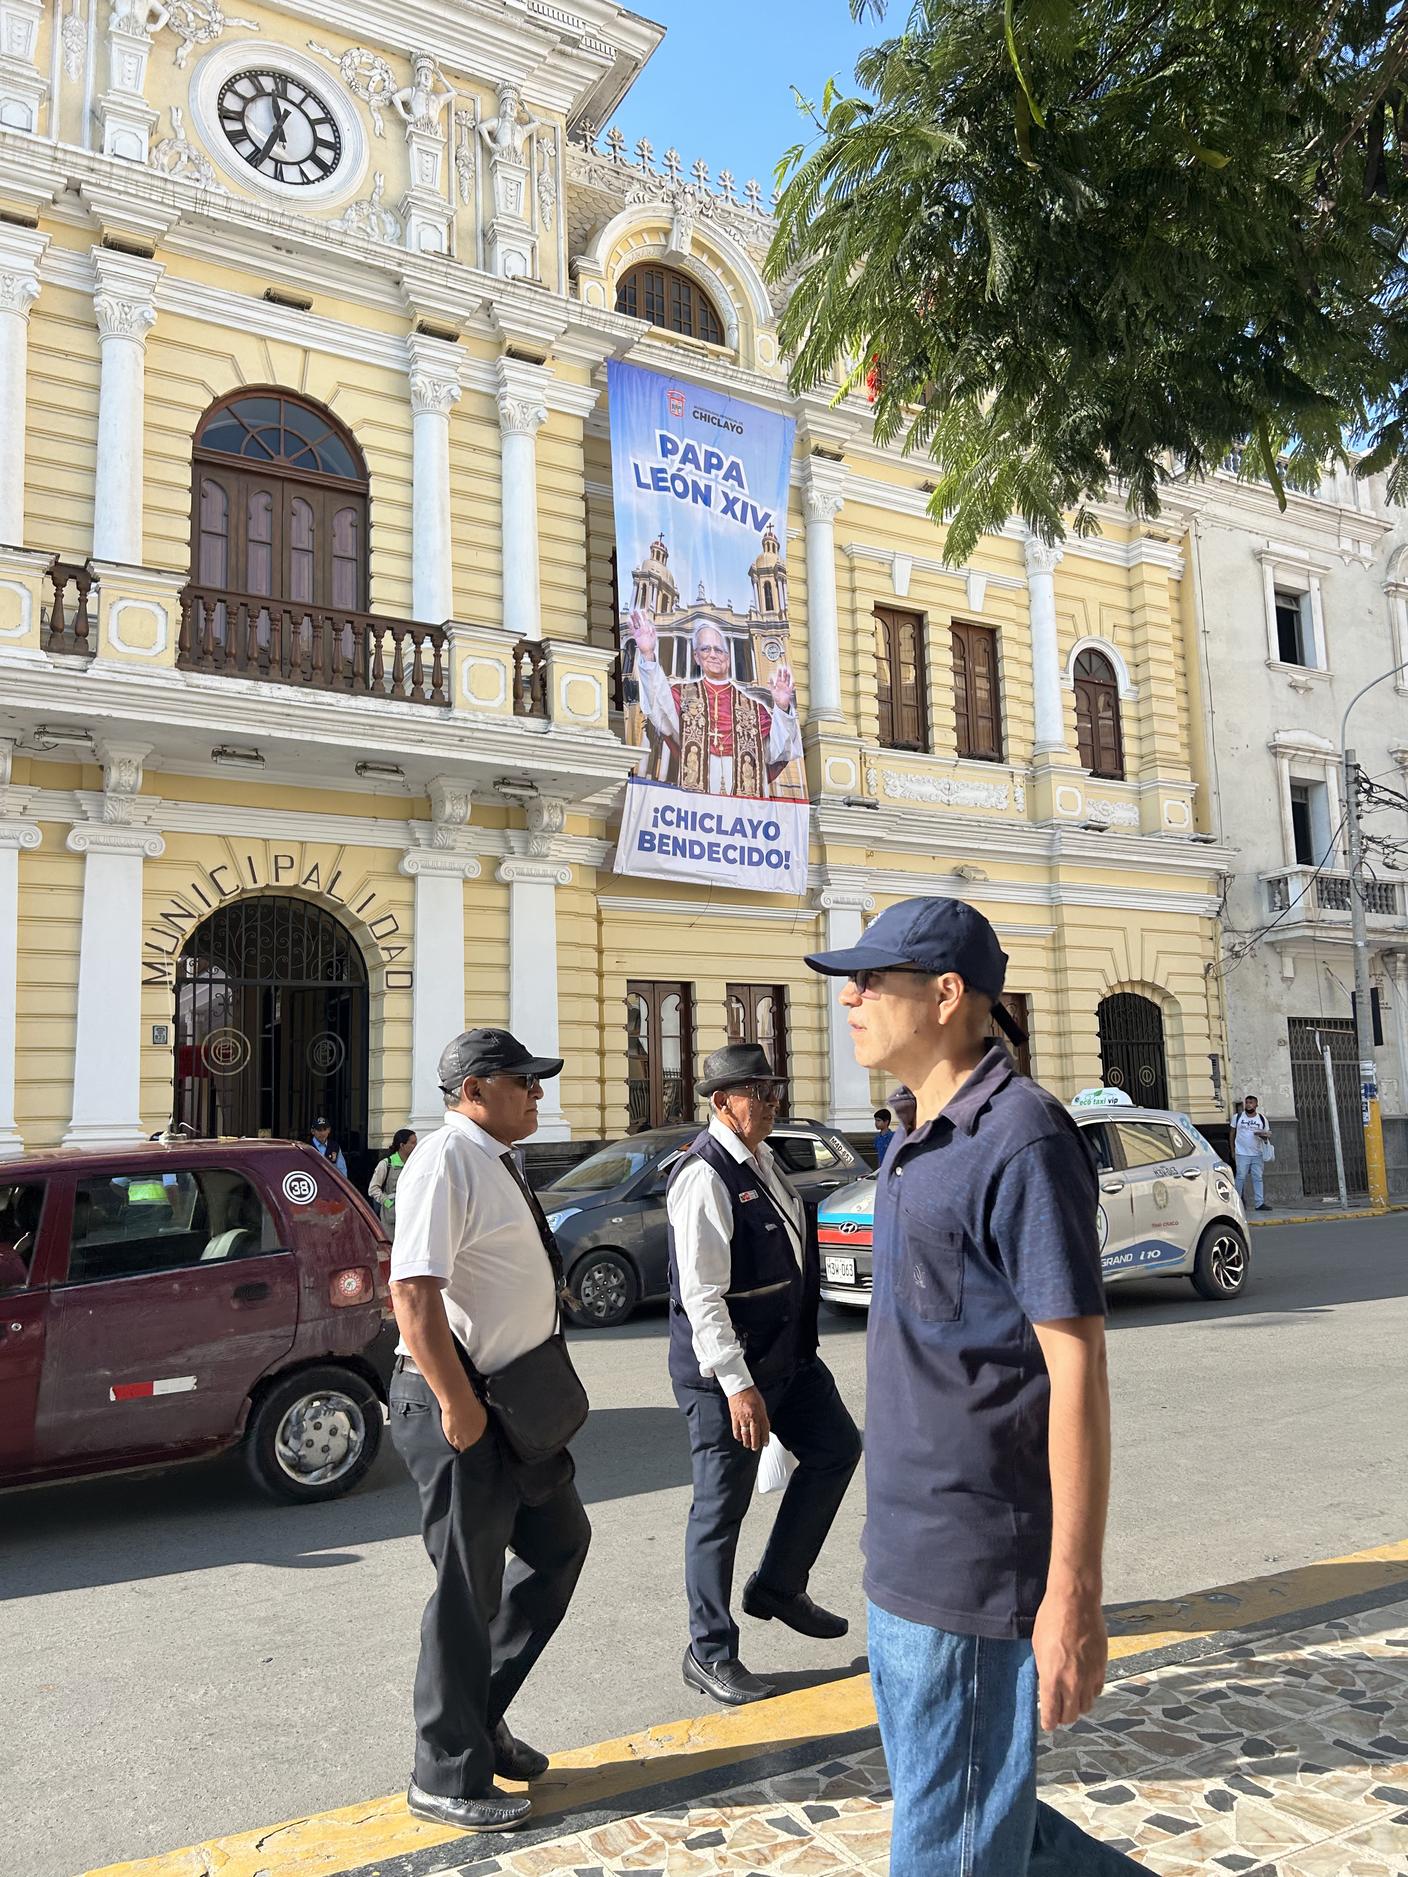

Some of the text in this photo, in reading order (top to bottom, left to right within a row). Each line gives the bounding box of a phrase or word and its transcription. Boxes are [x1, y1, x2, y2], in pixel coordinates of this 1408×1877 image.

[692, 410, 744, 435] CHICLAYO
[659, 433, 746, 490] PAPA
[632, 462, 772, 533] LEÓN XIV
[651, 805, 781, 842] ¡CHICLAYO
[637, 830, 791, 870] BENDECIDO!
[142, 854, 413, 989] MUNICIPALIDAD
[1093, 1097, 1107, 1105] taxi
[1108, 1097, 1119, 1105] vip
[291, 1181, 309, 1196] 38
[1101, 1253, 1133, 1267] GRAND
